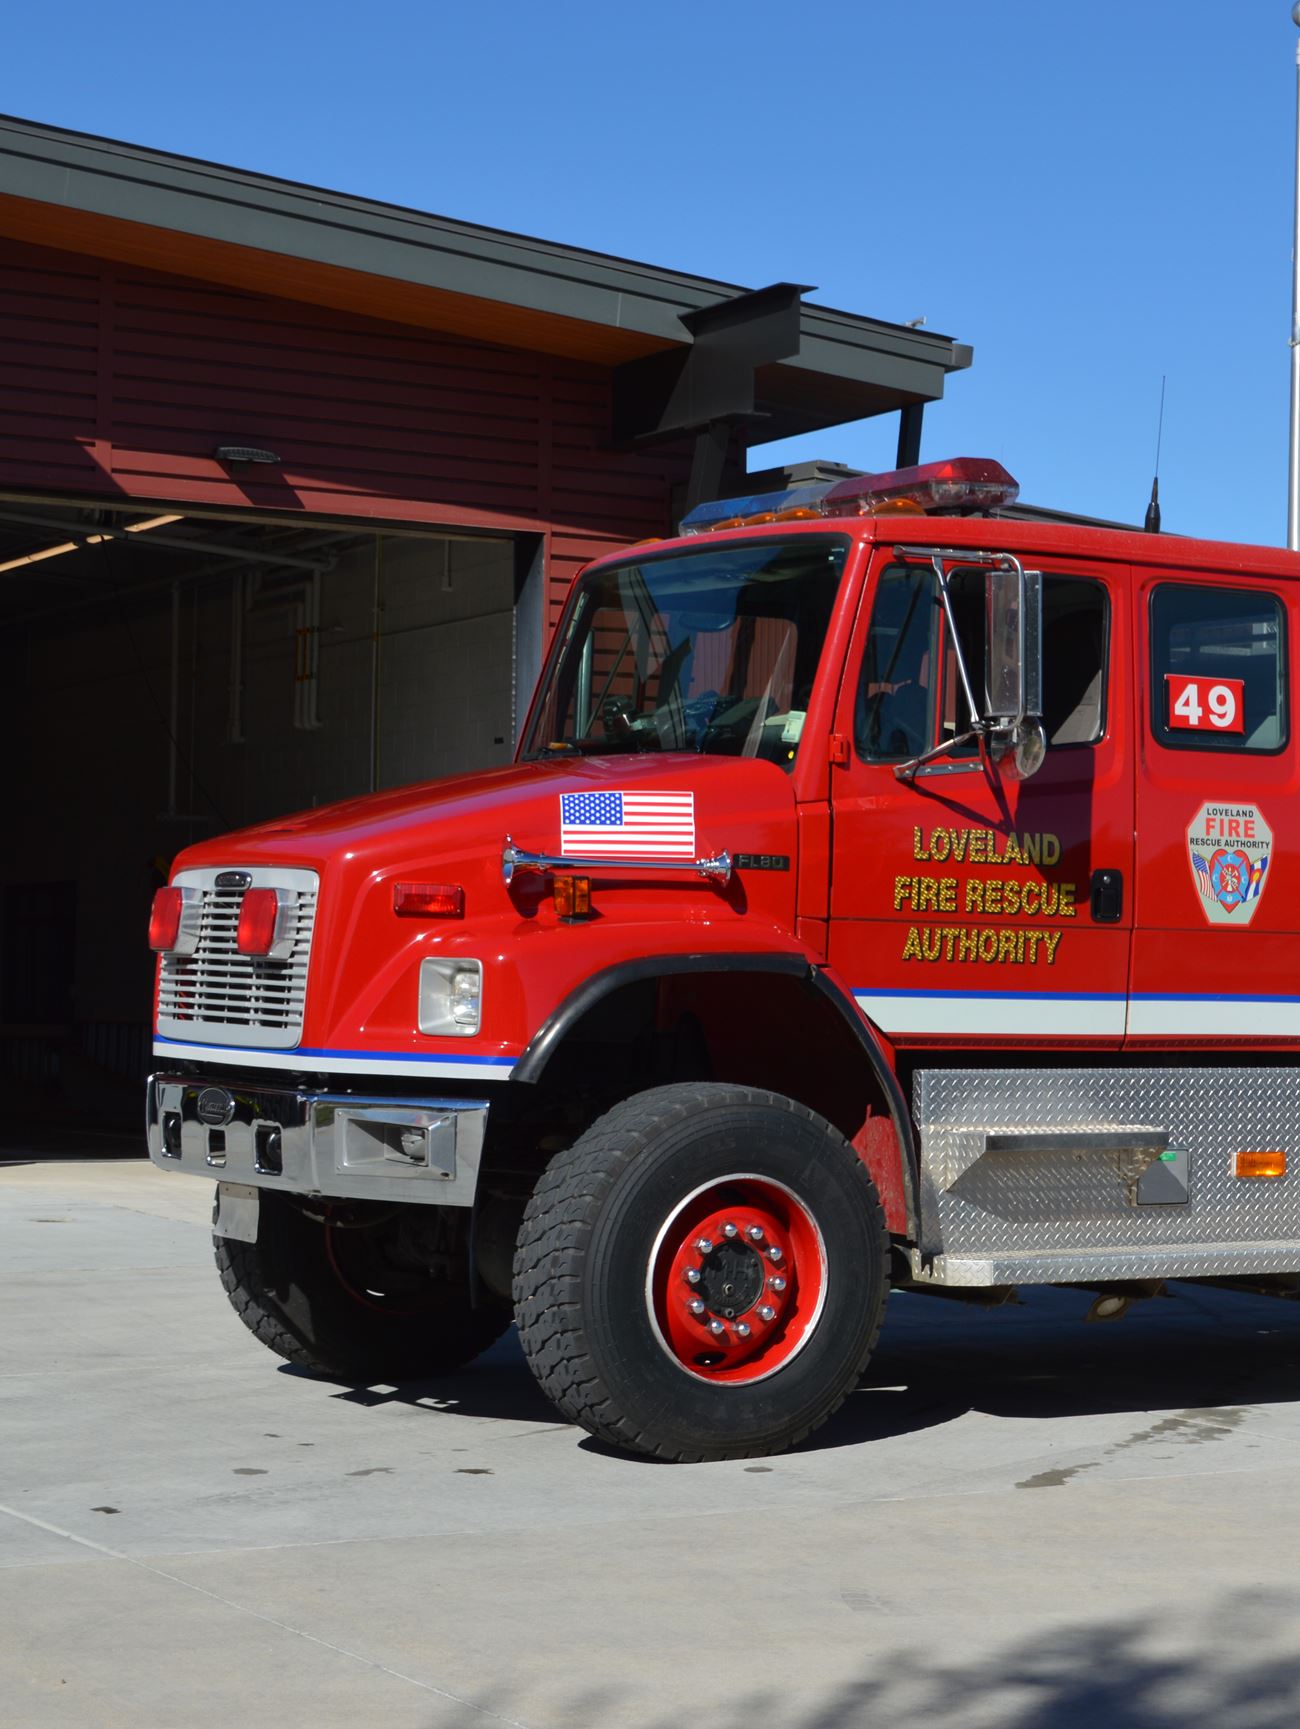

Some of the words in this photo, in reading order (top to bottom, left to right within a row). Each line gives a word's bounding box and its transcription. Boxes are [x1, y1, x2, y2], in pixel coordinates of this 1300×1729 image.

[1174, 683, 1236, 728] 49
[1205, 817, 1255, 838] FIRE
[1206, 808, 1254, 818] LOVELAND
[912, 826, 1061, 866] LOVELAND
[1190, 837, 1222, 847] RESCUE
[1224, 839, 1270, 849] AUTHORITY
[739, 855, 783, 868] FL80
[894, 875, 958, 913] FIRE
[965, 878, 1077, 917] RESCUE
[902, 927, 1062, 965] AUTHORITY
